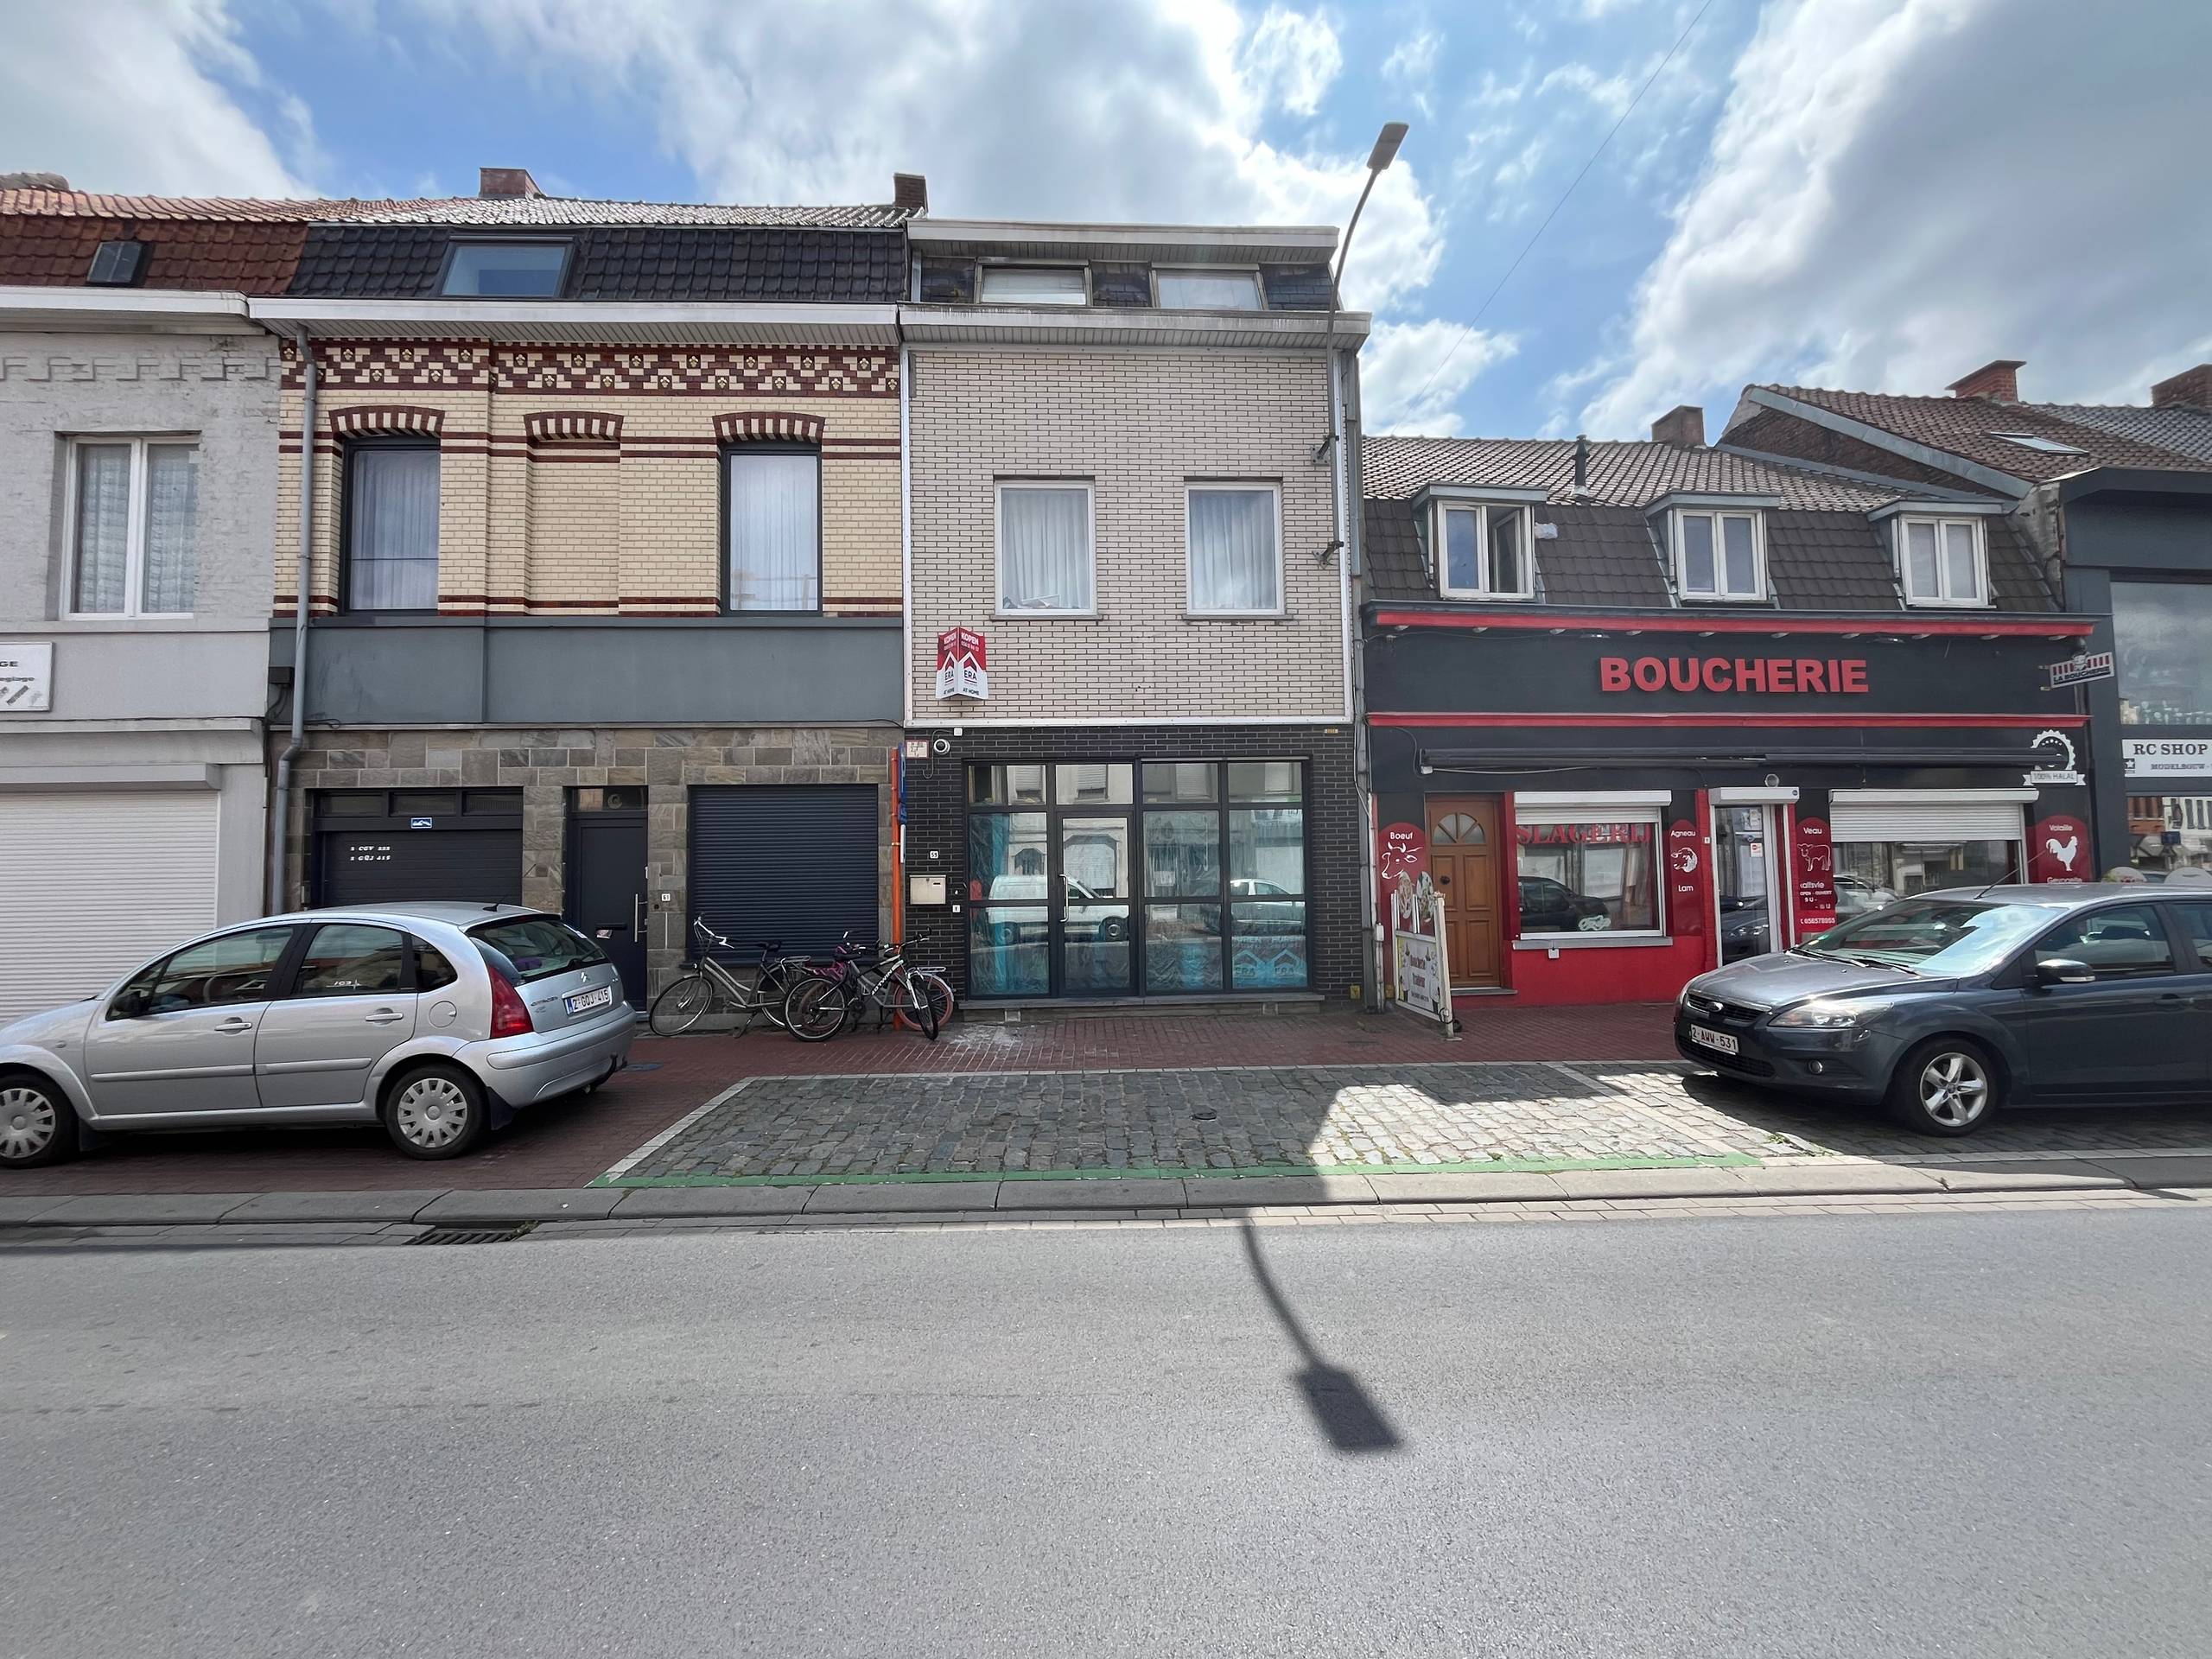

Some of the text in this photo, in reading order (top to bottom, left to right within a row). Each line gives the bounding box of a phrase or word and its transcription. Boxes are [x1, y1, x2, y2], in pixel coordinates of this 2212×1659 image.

[961, 632, 979, 645] KOPEN
[944, 671, 954, 680] ERA
[963, 671, 977, 680] ERA
[1600, 657, 1869, 692] BOUCHERIE
[2133, 744, 2208, 755] RC SHOP
[1390, 831, 1413, 840] Boeuf
